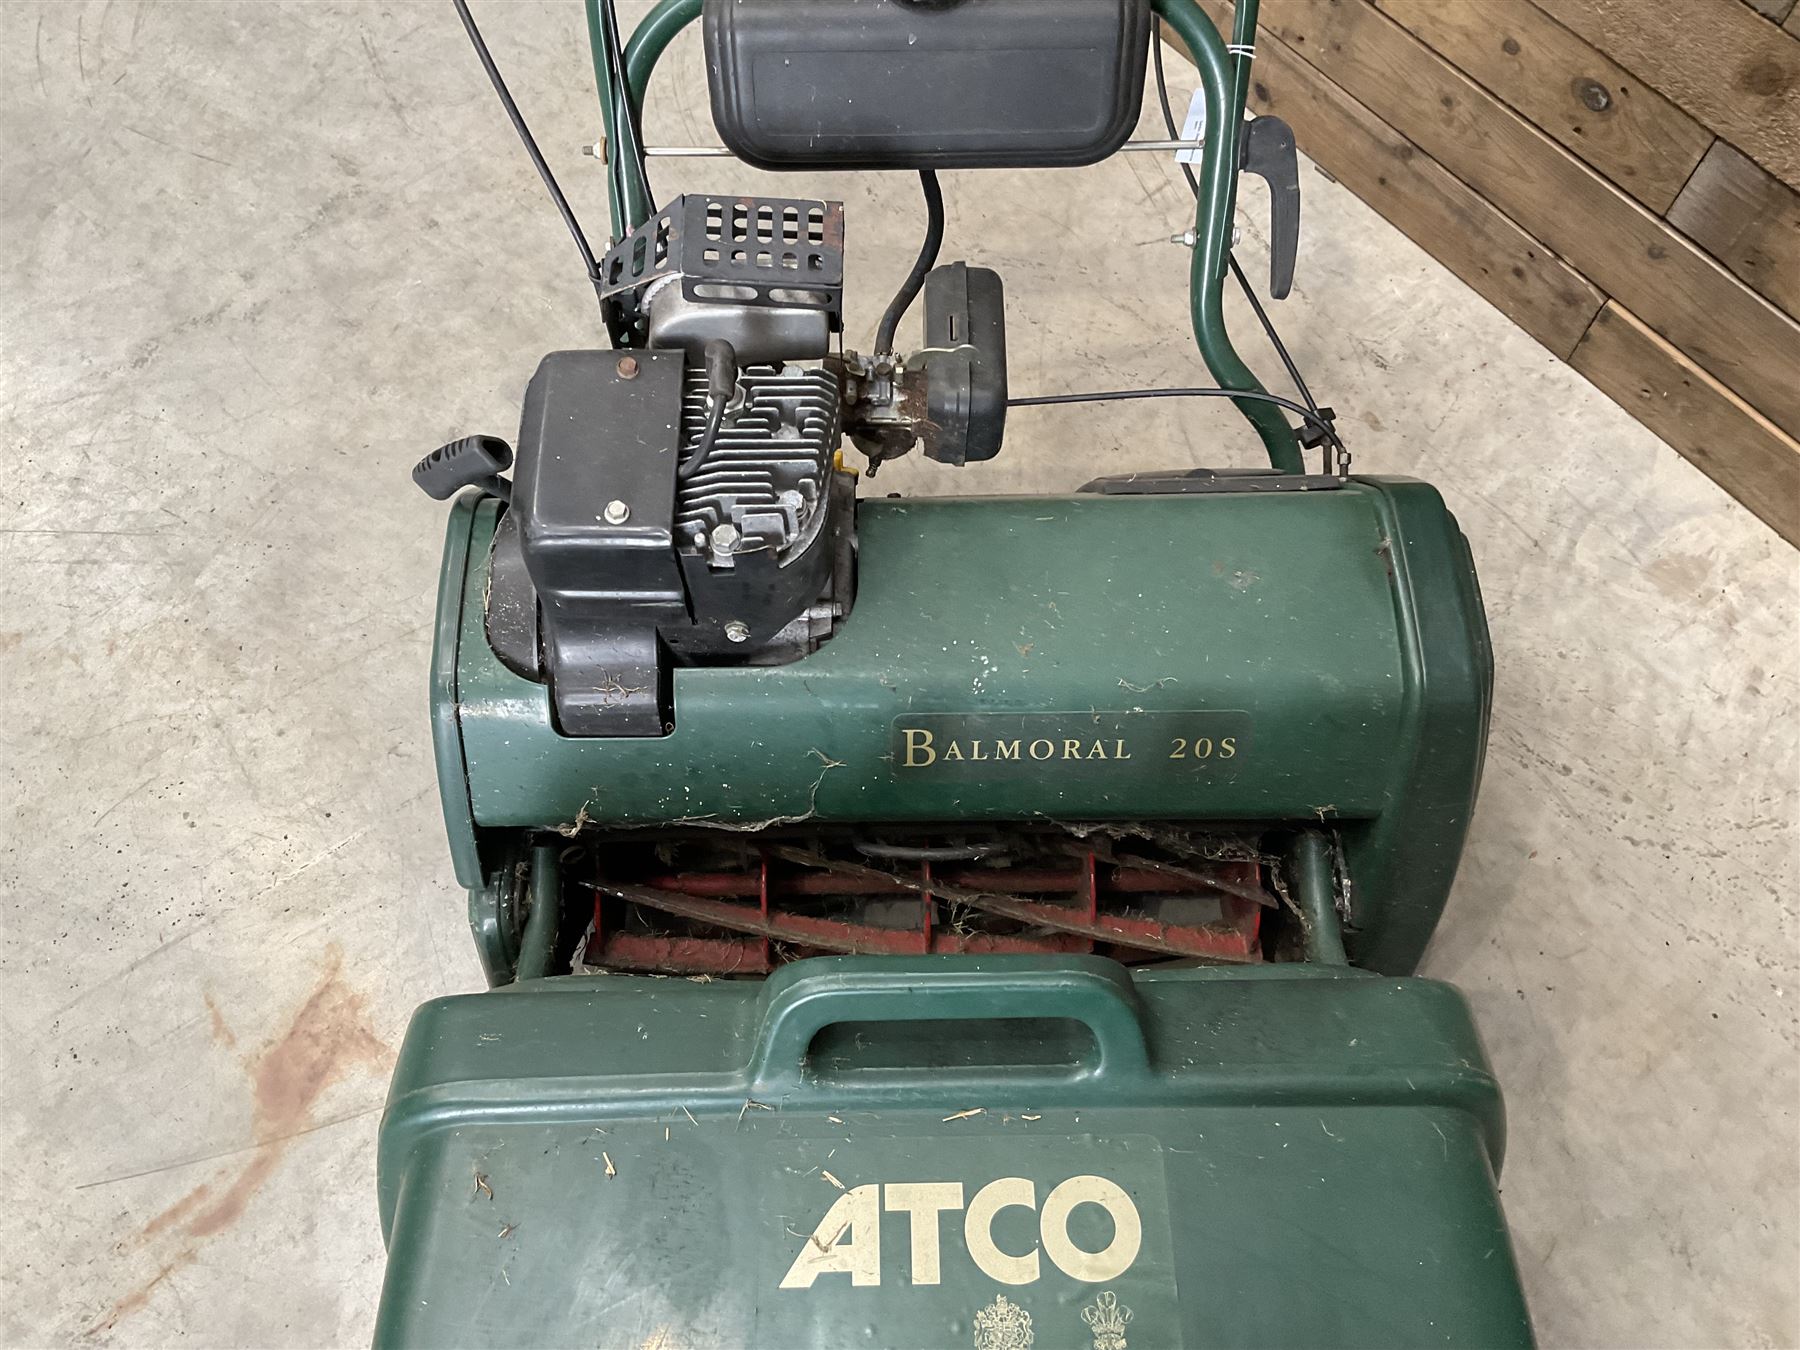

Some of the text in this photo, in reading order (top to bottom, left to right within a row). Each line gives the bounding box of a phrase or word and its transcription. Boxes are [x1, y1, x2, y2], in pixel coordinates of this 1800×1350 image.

[902, 729, 1236, 767] BALMORAL 20S
[779, 1175, 1142, 1288] ATCO
